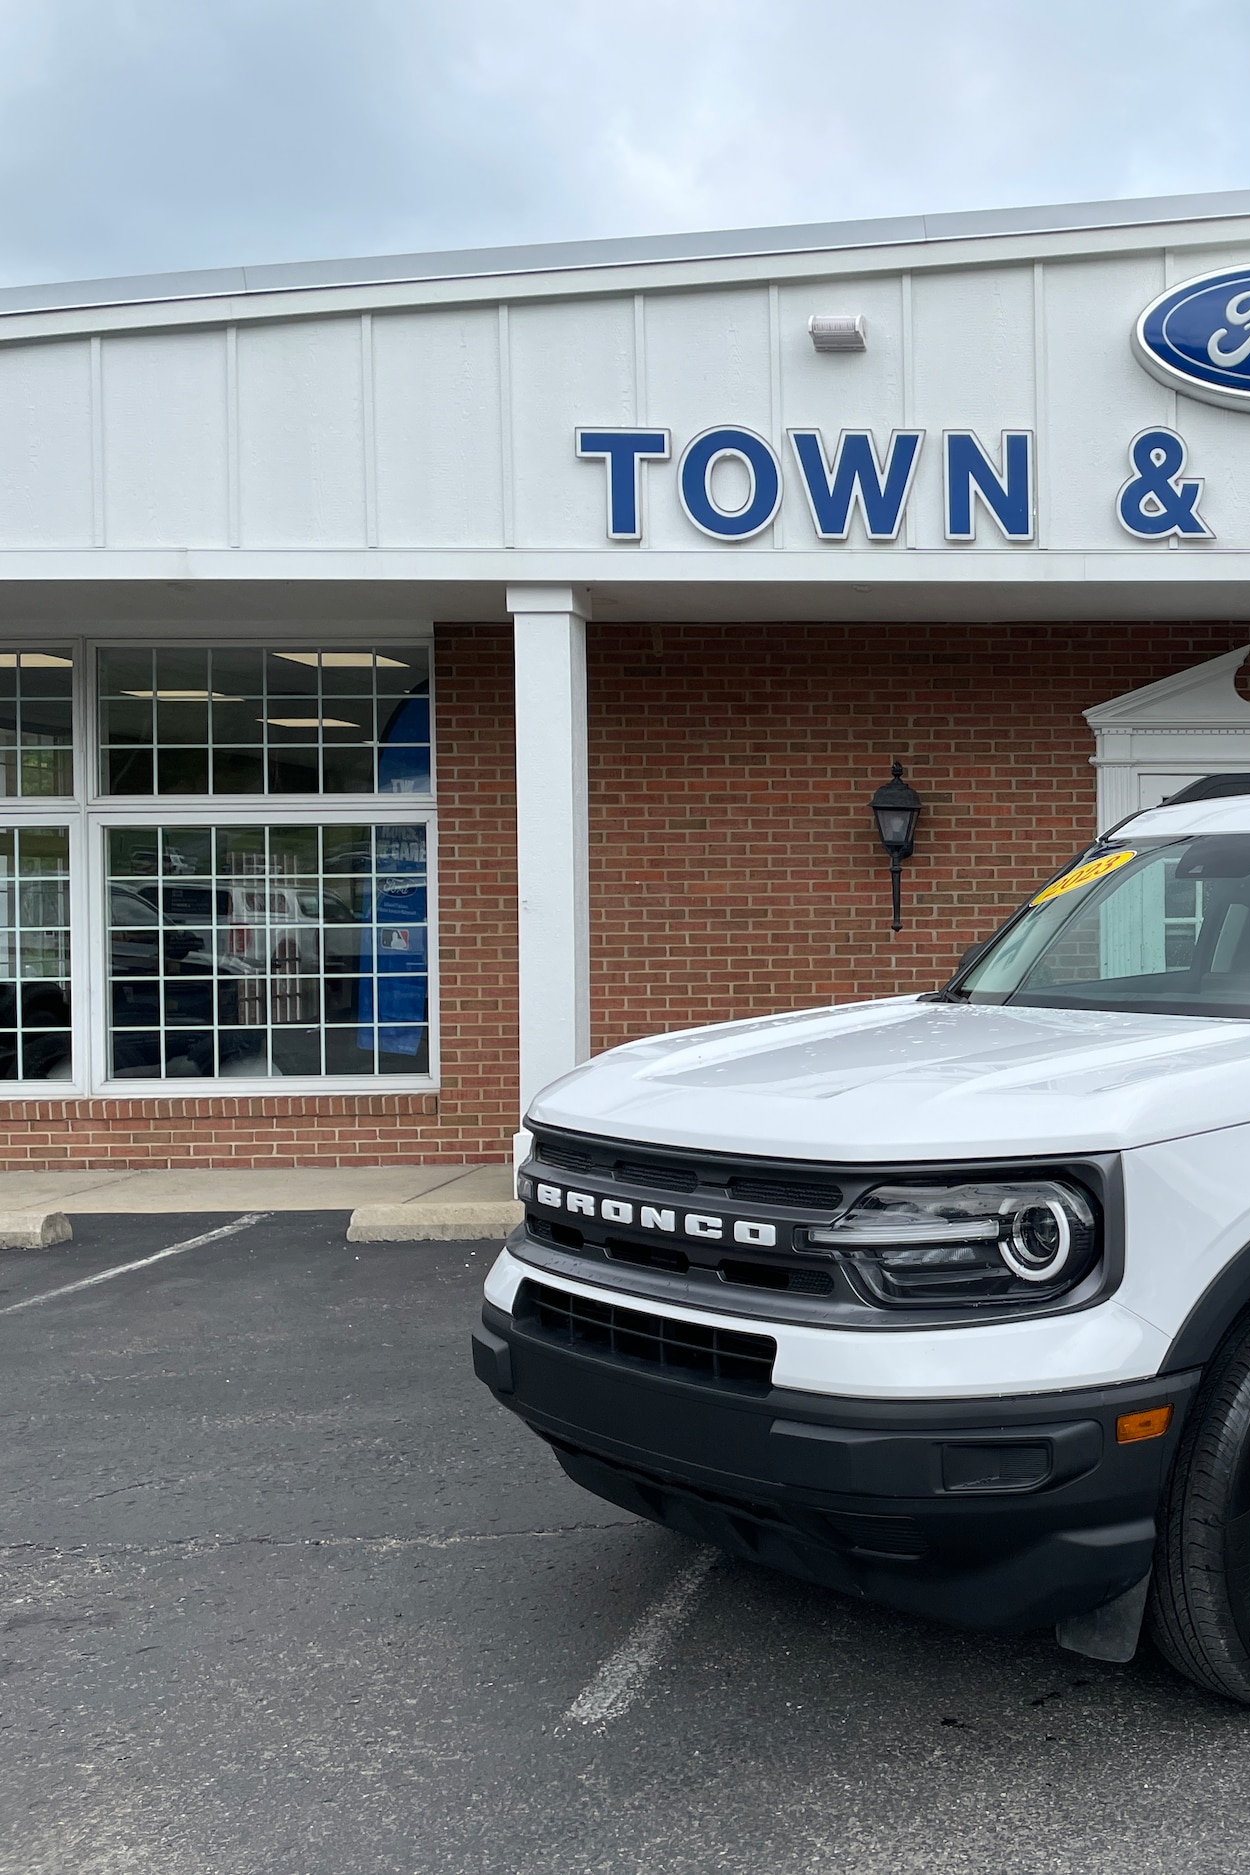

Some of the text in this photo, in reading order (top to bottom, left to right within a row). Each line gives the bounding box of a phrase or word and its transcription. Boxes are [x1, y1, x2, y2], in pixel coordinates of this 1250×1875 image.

[575, 424, 1035, 541] TOWN
[1116, 425, 1217, 541] &
[1043, 855, 1121, 899] 2023
[537, 1183, 776, 1247] BRONCO
